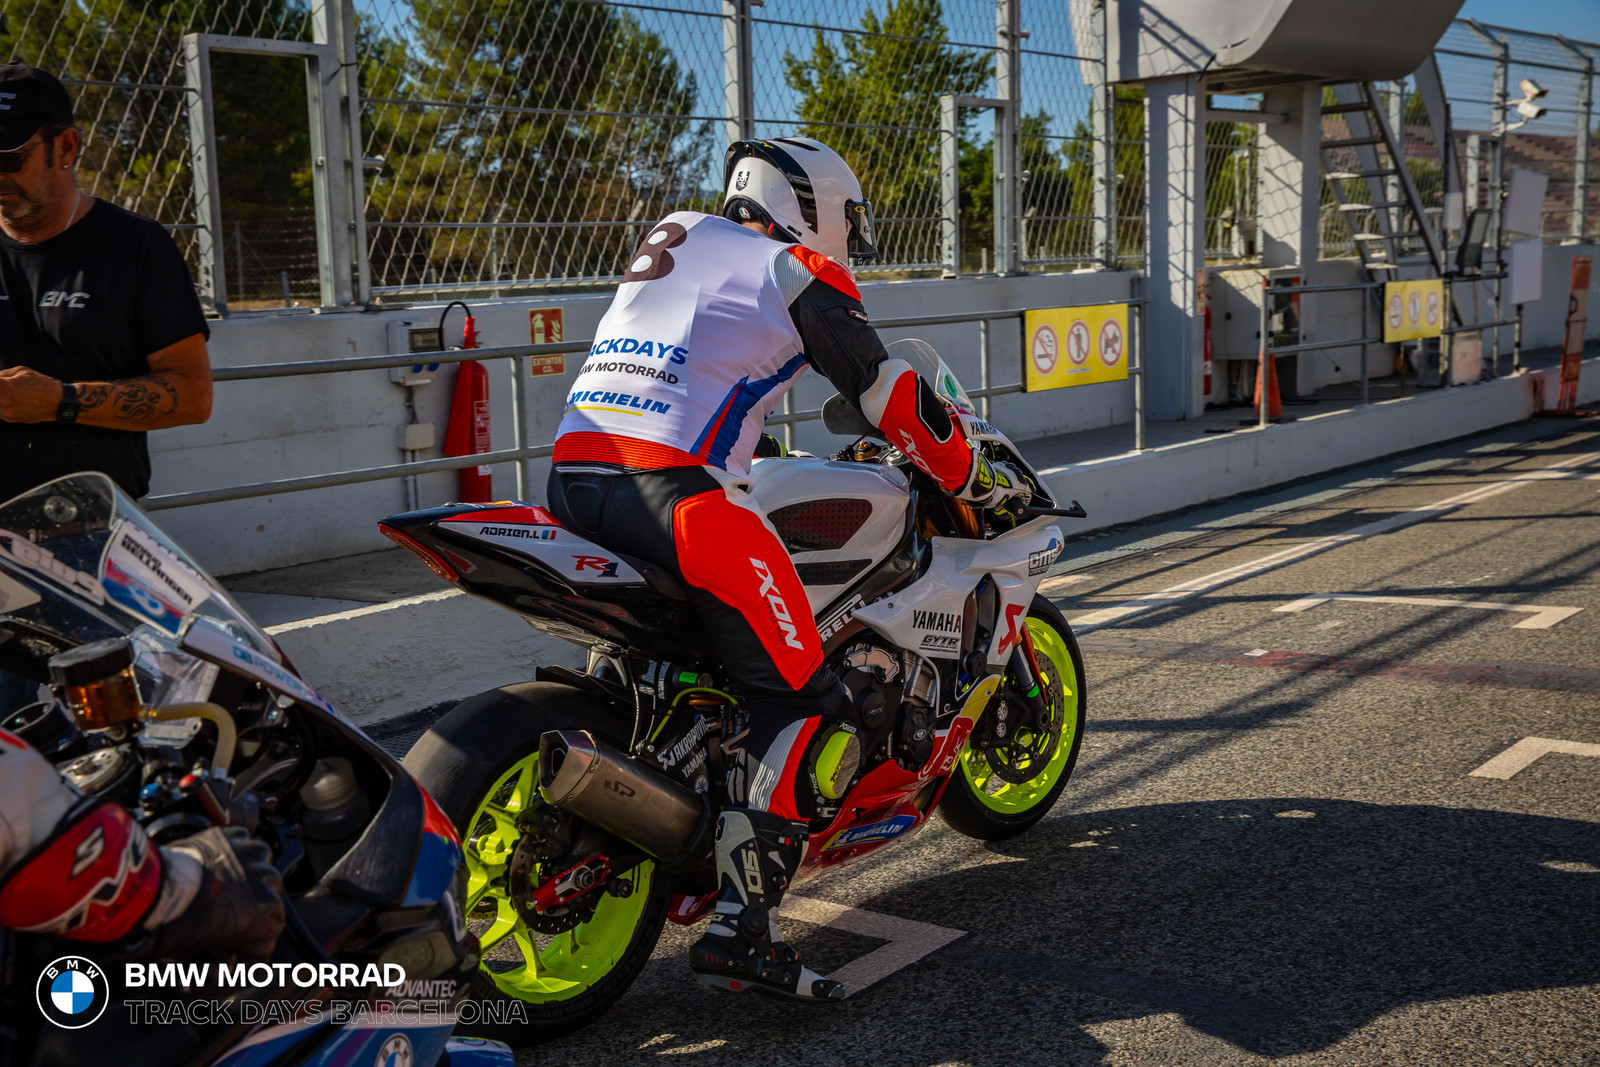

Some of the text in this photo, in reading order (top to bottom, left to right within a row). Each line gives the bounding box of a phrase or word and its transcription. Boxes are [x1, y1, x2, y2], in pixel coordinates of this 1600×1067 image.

[39, 290, 90, 308] BMC
[532, 356, 562, 367] EXTINTOR
[595, 361, 679, 385] MOTORRAD
[569, 390, 672, 415] MICHELIN
[969, 421, 999, 436] YAMAHA
[570, 555, 619, 577] R1
[912, 609, 962, 634] YAMAHA
[922, 634, 961, 646] GYTR
[681, 746, 708, 778] YAMAHA
[849, 824, 905, 842] MICHELIN
[384, 979, 456, 998] ADVANTEC
